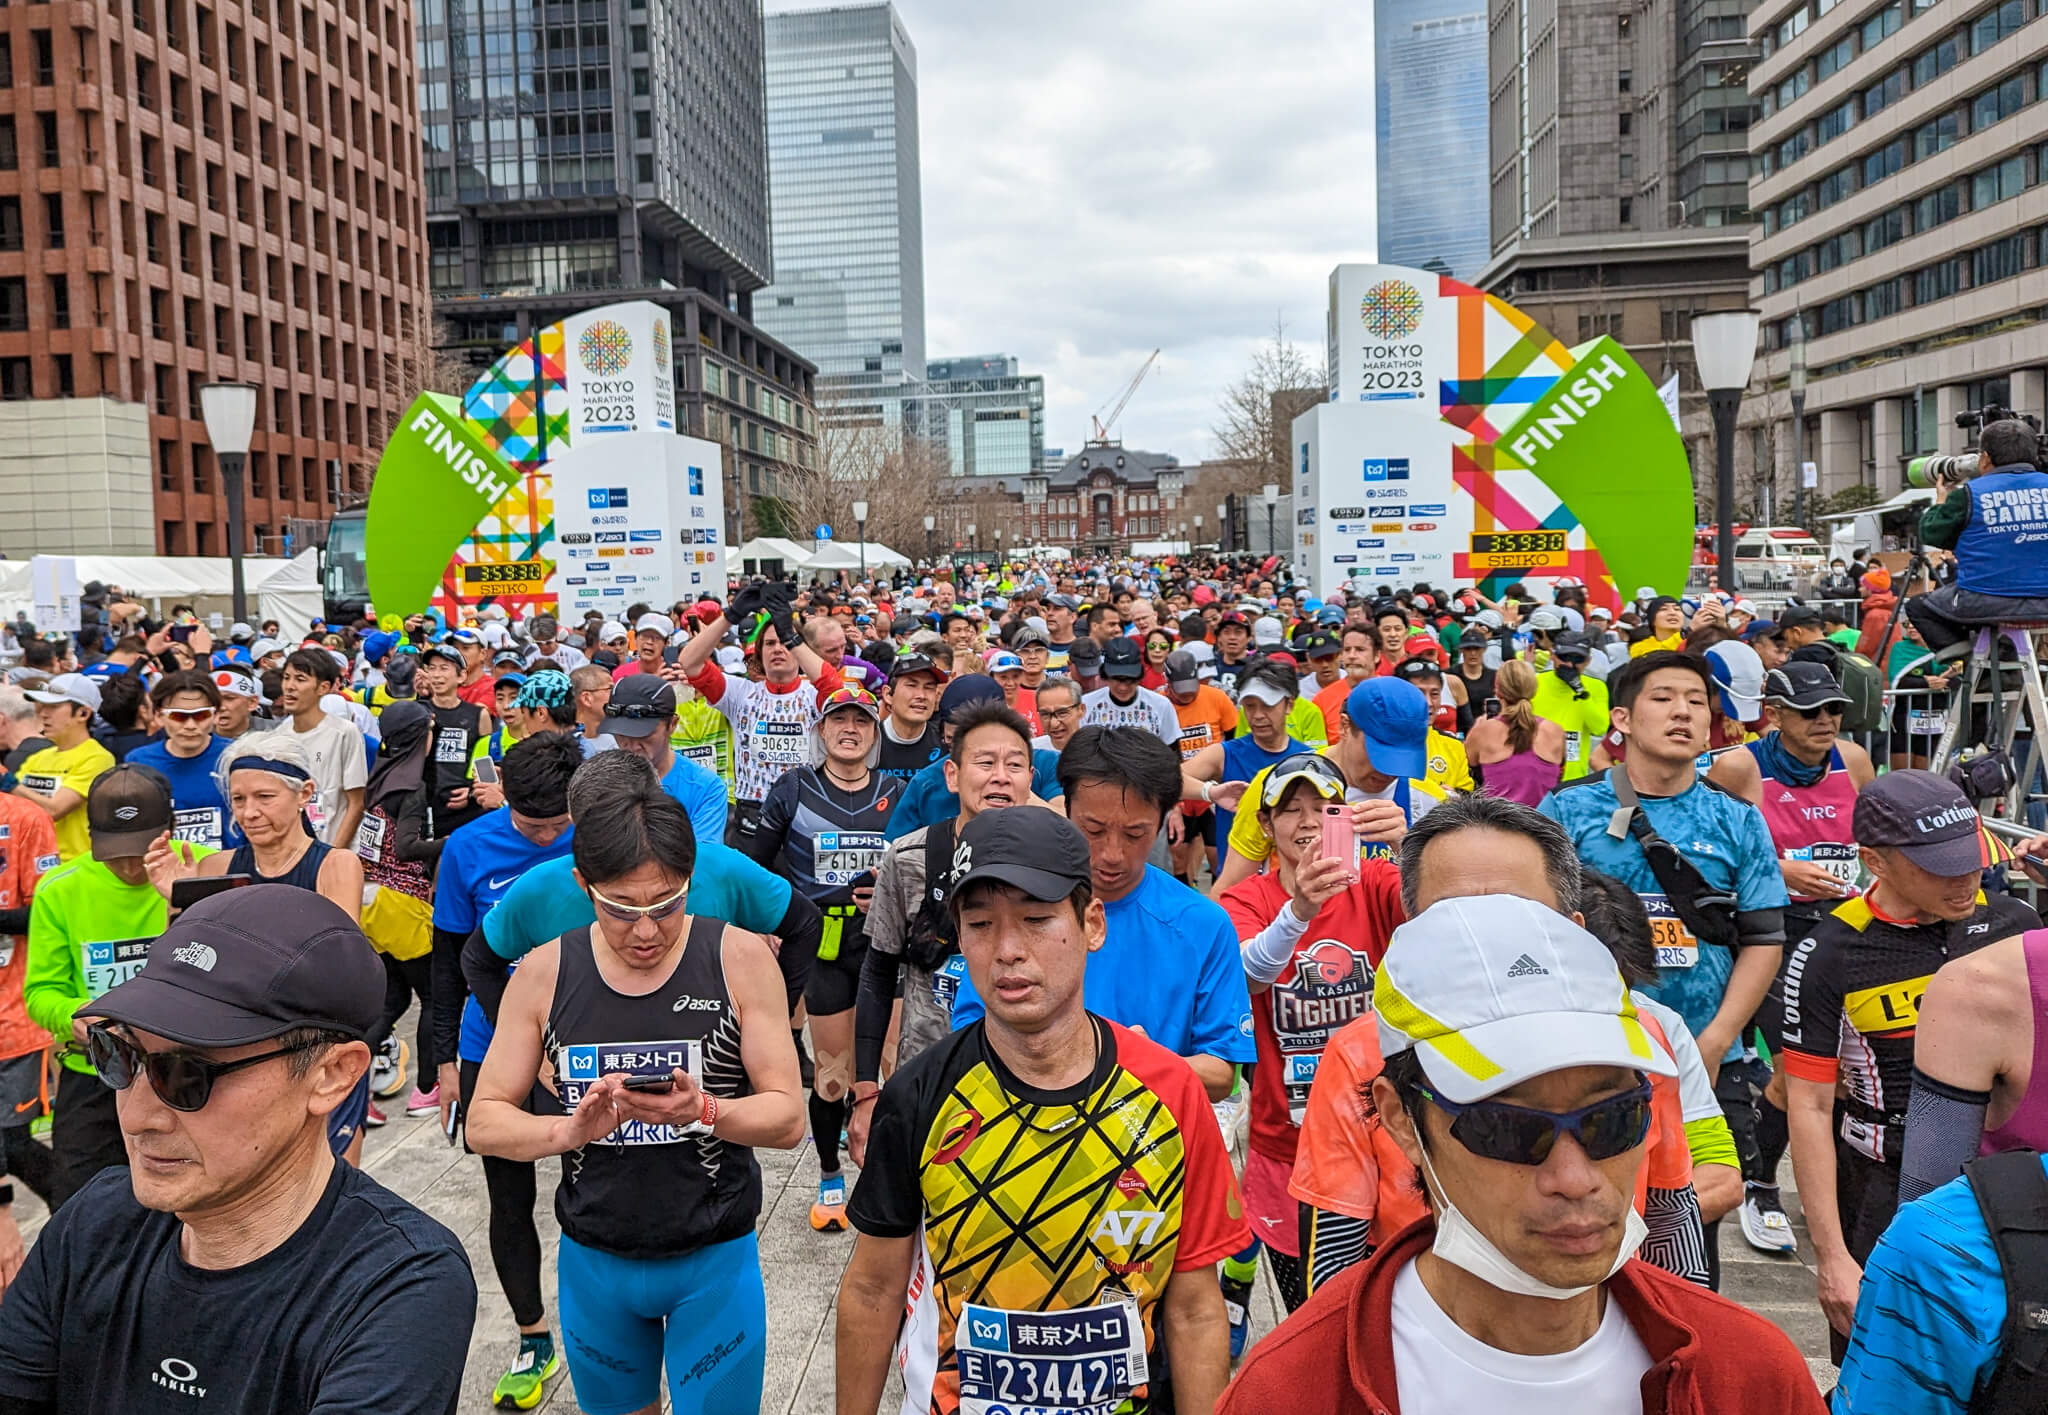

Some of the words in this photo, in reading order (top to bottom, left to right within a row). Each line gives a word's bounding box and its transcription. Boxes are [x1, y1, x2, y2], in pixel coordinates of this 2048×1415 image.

[1362, 344, 1423, 359] TOKYO
[1363, 360, 1422, 369] MARATHON
[582, 380, 634, 394] TOKYO
[1363, 370, 1423, 390] 2023
[583, 395, 634, 404] MARATHON
[583, 404, 635, 423] 2023
[1510, 353, 1627, 466] FINISH
[409, 408, 508, 504] FINISH
[1987, 523, 2019, 533] TOKYO
[1489, 534, 1563, 552] 3:59:30
[1488, 553, 1549, 567] SEIKO
[480, 583, 528, 595] SEIKO
[762, 737, 797, 751] 90692
[1801, 805, 1837, 821] YRC
[831, 852, 875, 870] 61914
[190, 941, 206, 951] THE
[174, 953, 196, 964] FACE
[88, 971, 98, 983] E
[1507, 966, 1549, 978] adidas
[938, 979, 949, 991] E
[1316, 982, 1357, 997] KASAI
[1782, 937, 1817, 1045] L'ottimo
[688, 998, 721, 1011] asics
[604, 1051, 682, 1070] 東京メトロ
[568, 1086, 581, 1104] B
[1292, 1088, 1305, 1099] E
[1090, 1210, 1165, 1246] A77
[1017, 1318, 1122, 1347] 東京メトロ
[696, 1330, 746, 1381] FORCE
[966, 1356, 984, 1381] E
[996, 1358, 1109, 1405] 23442
[1116, 1367, 1127, 1385] 2
[152, 1372, 207, 1398] OAKLEY
